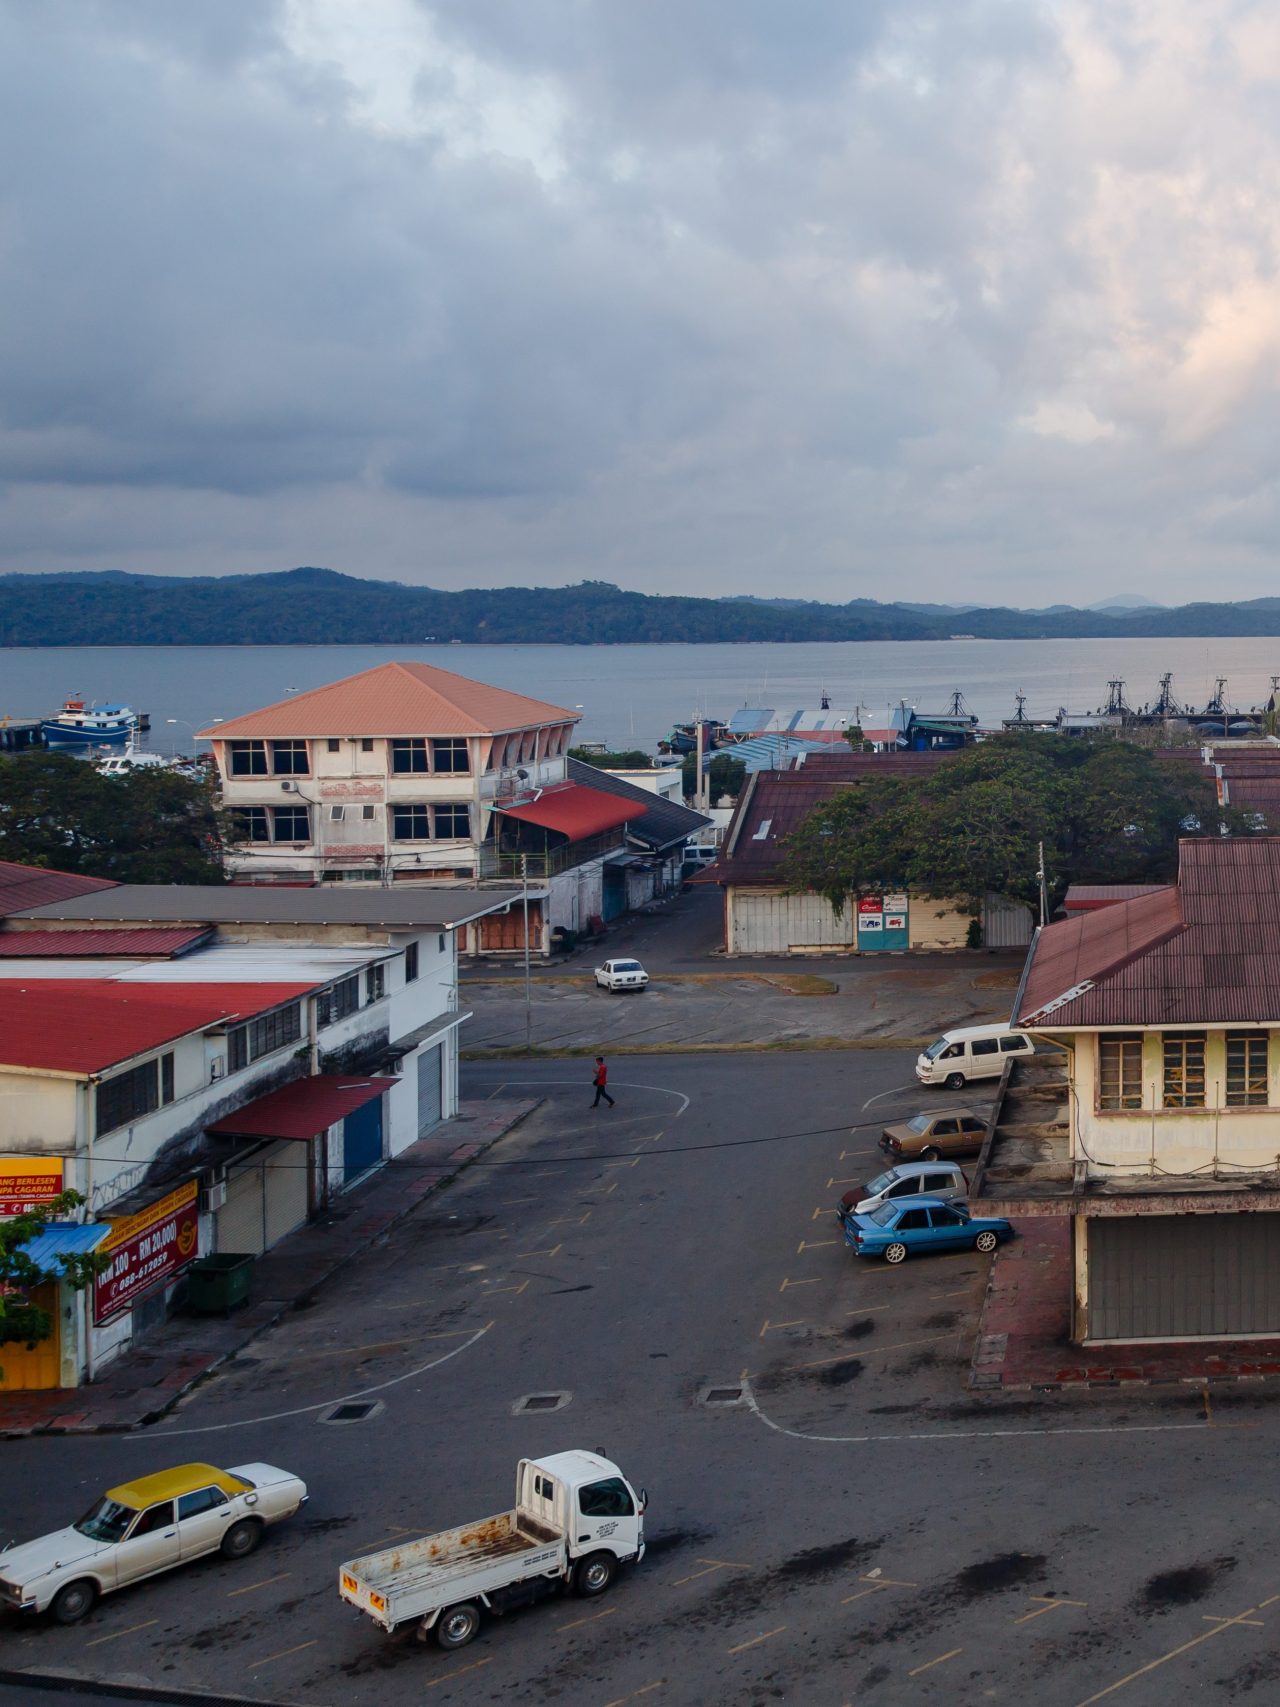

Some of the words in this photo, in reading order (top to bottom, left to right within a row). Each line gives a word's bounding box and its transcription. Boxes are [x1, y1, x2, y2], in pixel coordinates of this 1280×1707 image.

[16, 1177, 56, 1185] BERLESEN
[14, 1186, 54, 1194] CAGARAN
[115, 1251, 129, 1276] 100
[139, 1237, 152, 1261] RM
